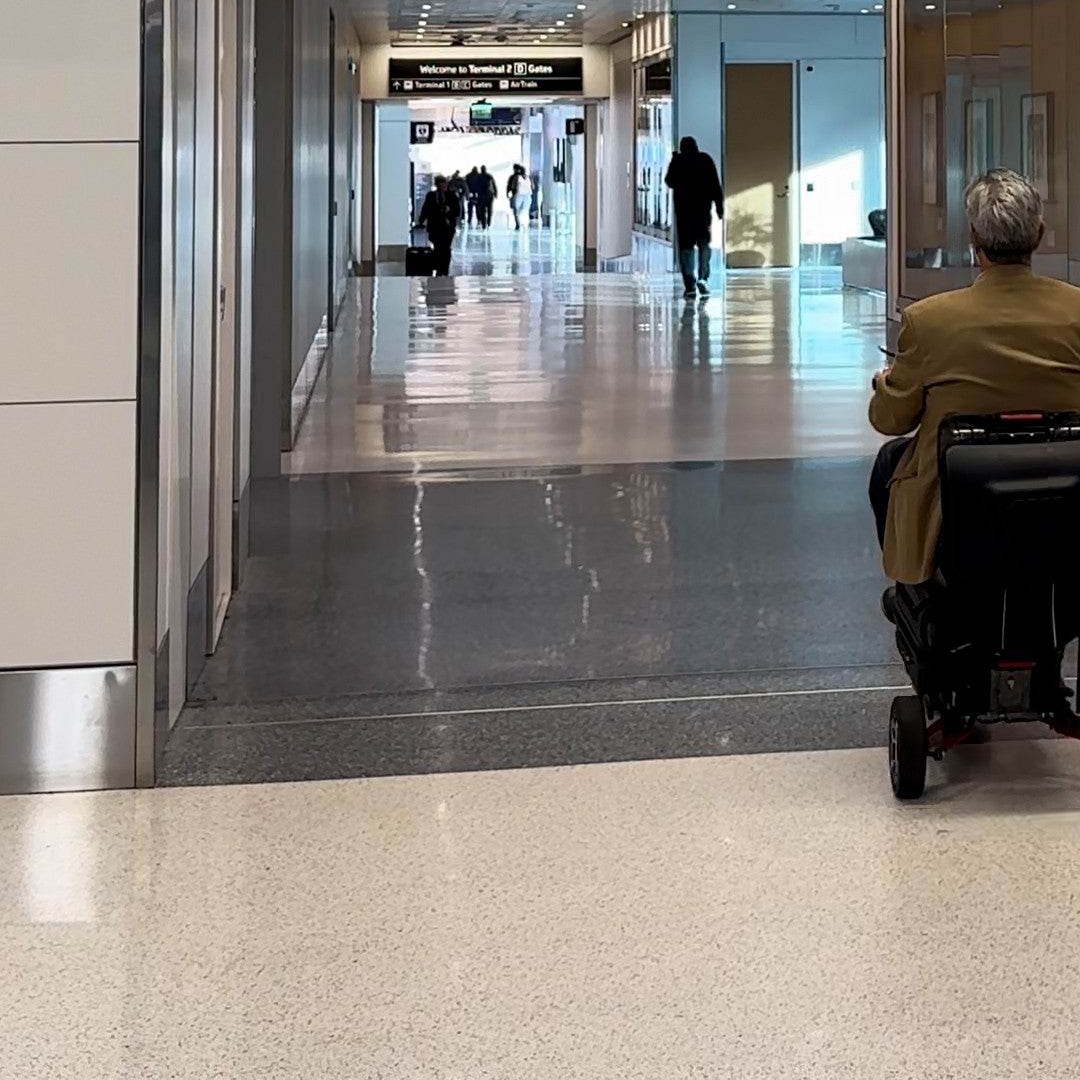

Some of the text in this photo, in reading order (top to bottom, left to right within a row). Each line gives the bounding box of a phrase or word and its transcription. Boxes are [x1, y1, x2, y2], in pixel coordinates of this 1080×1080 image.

[419, 63, 553, 74] Welcome to Terminal 2 D Gates
[415, 81, 445, 89] Terminal
[472, 81, 493, 89] Gates
[510, 80, 538, 88] AirTrain
